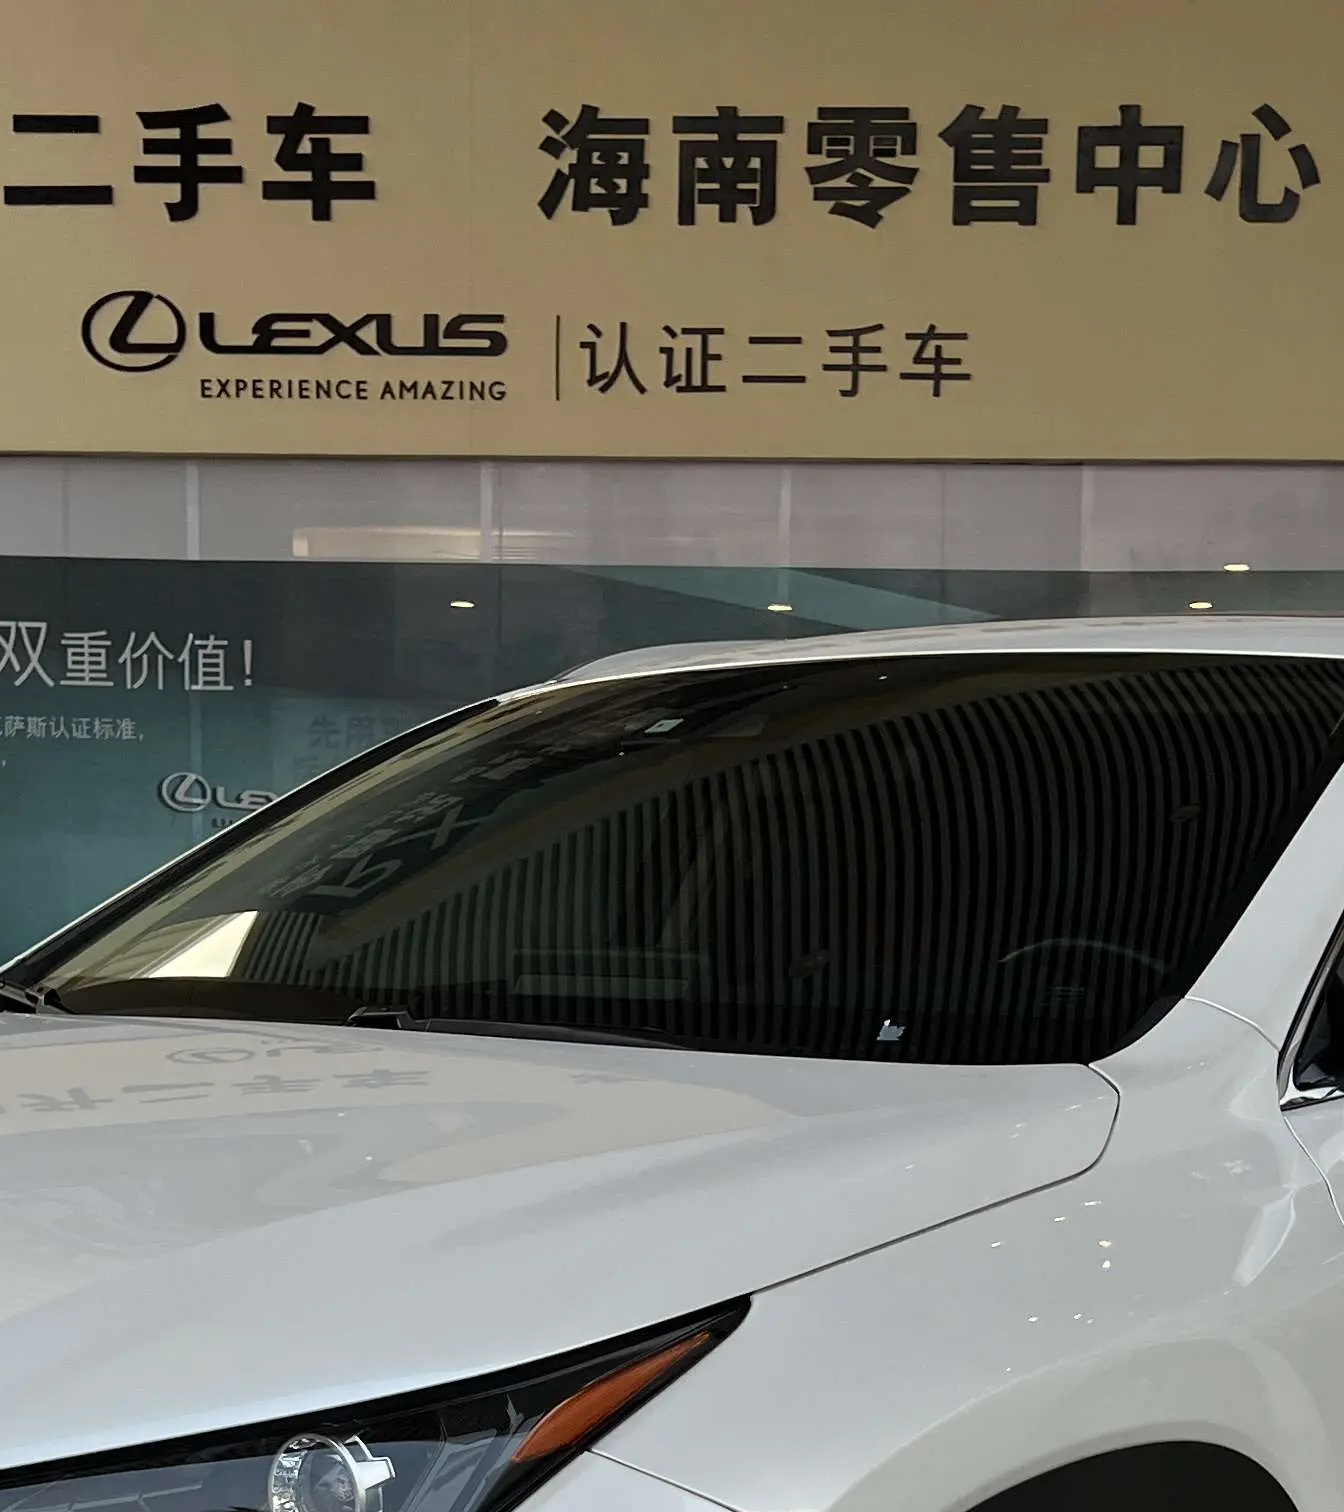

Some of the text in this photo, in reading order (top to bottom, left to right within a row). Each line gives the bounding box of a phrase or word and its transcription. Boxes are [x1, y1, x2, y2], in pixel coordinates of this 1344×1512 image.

[538, 103, 1321, 229] 海南零售中心
[199, 313, 508, 356] LEXUS
[580, 322, 973, 398] 认证二手车
[200, 378, 508, 401] EXPERIENCE AMAZING
